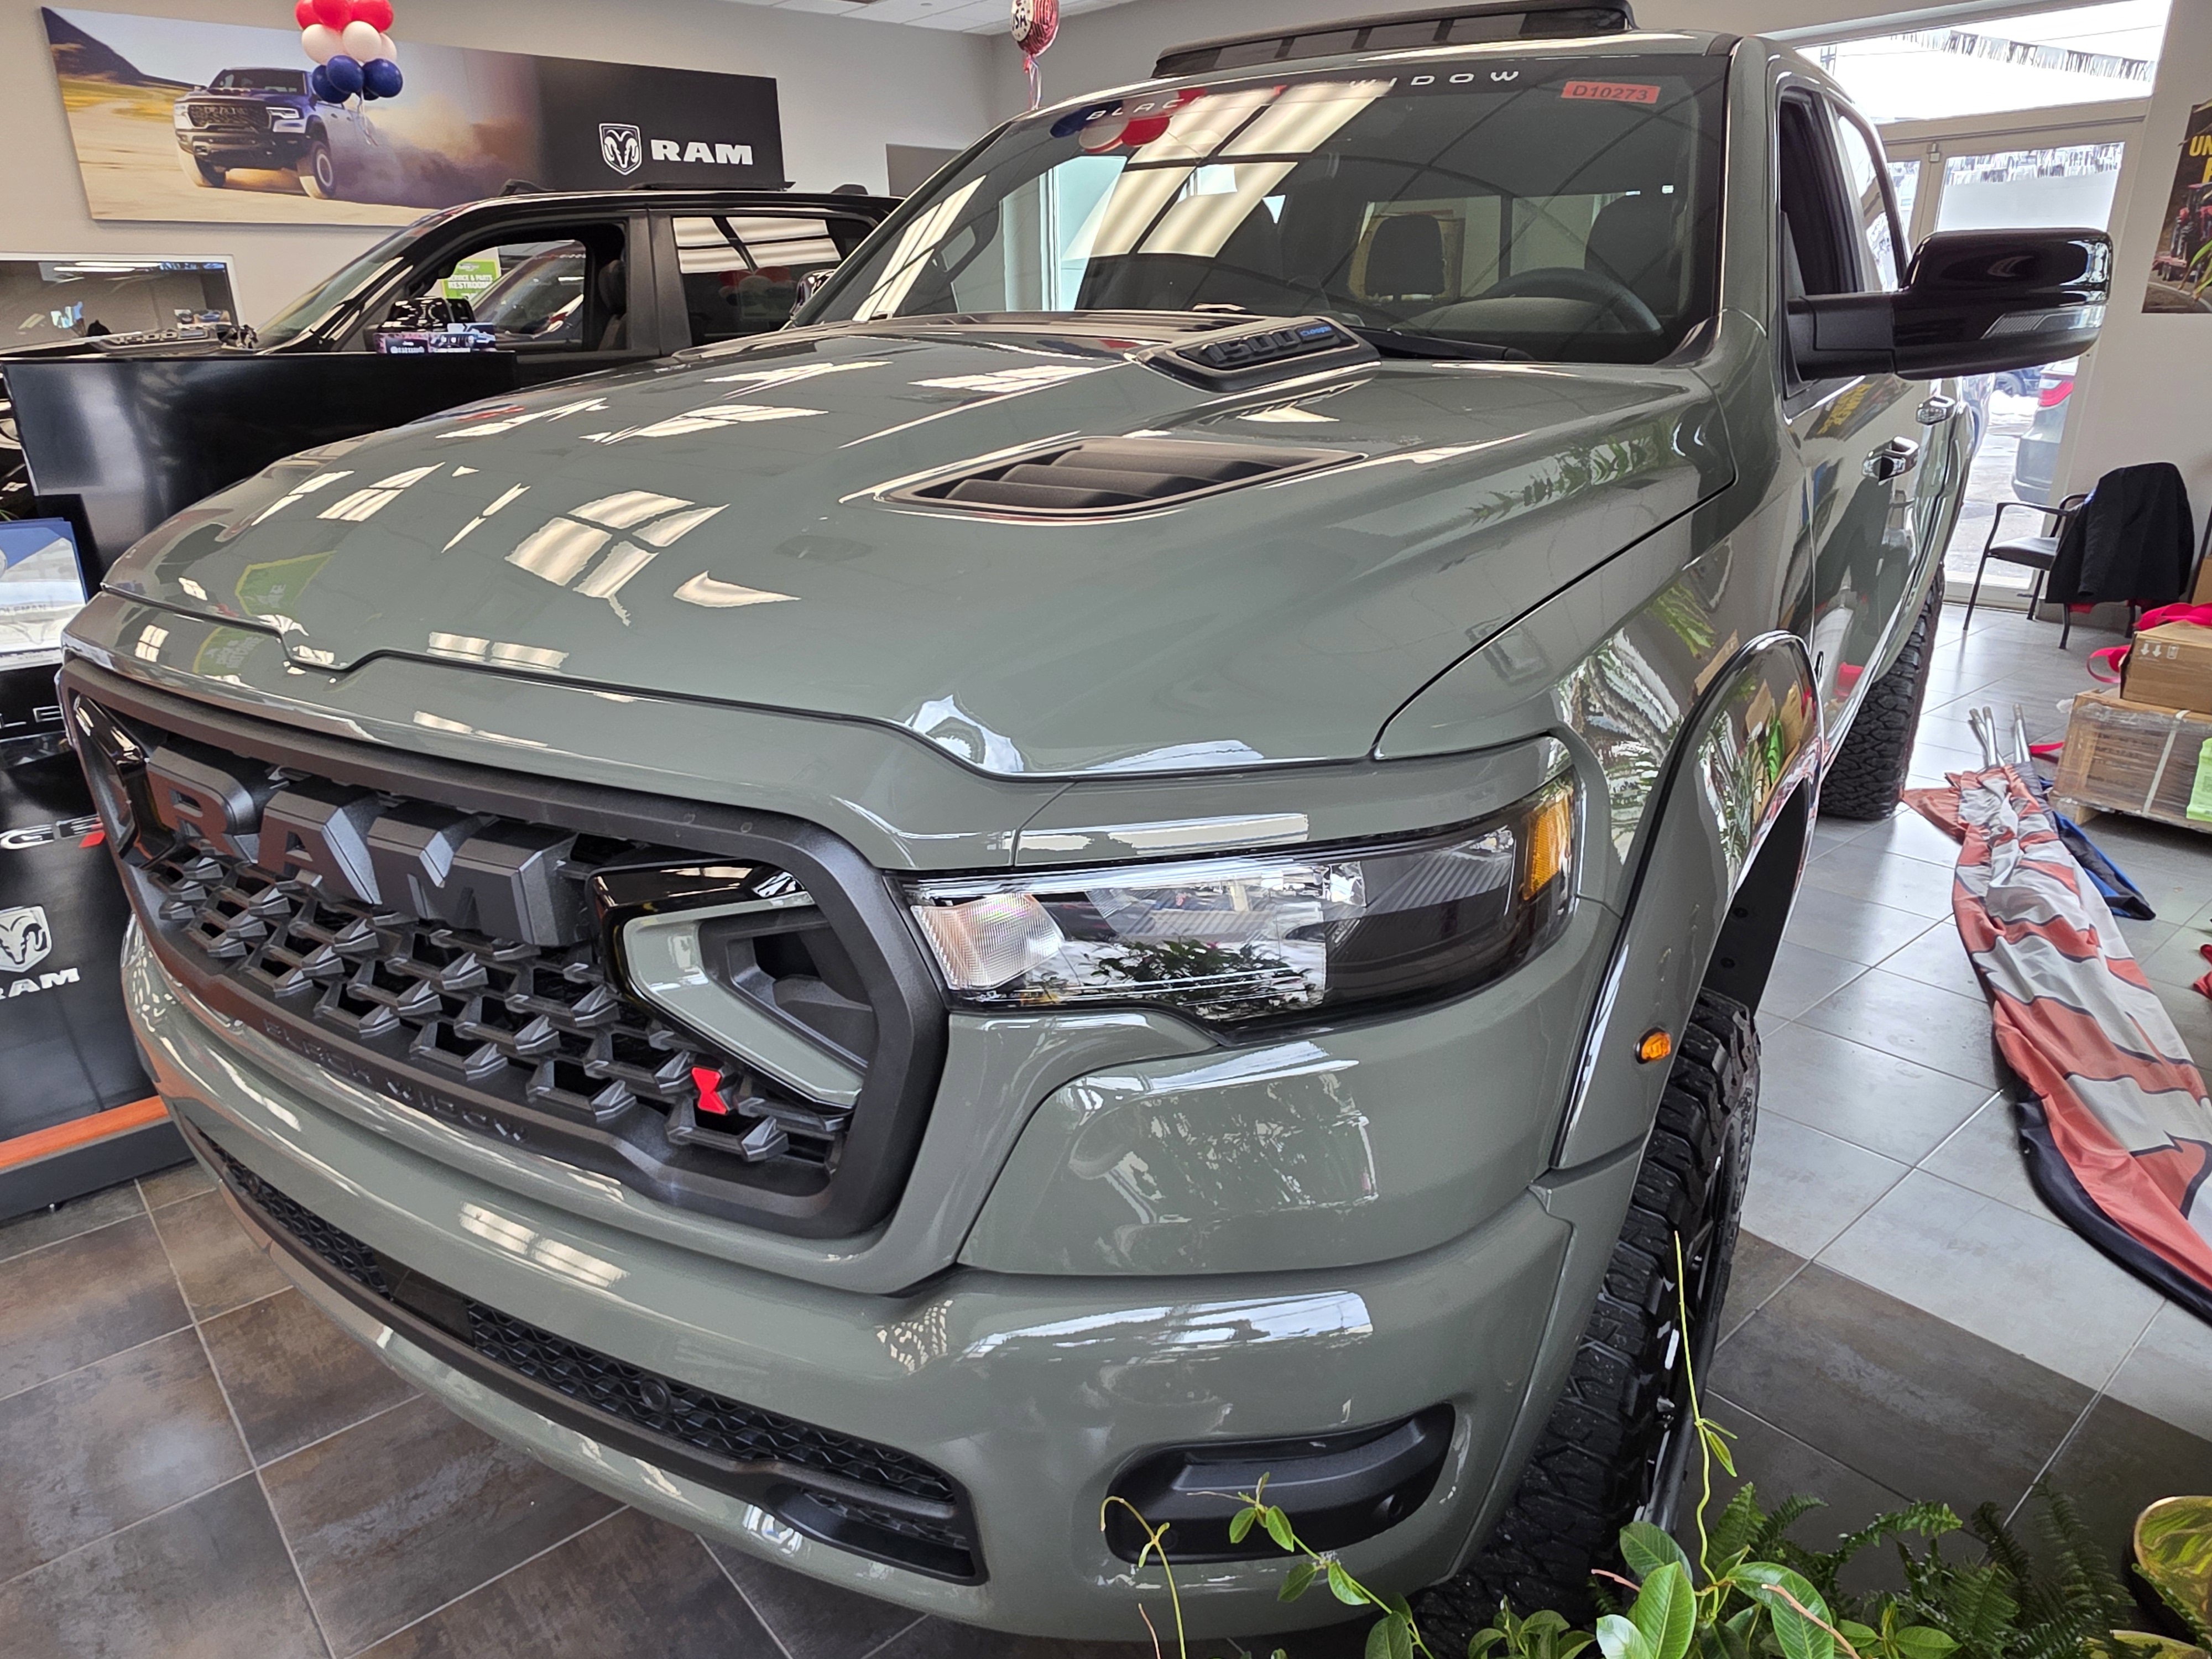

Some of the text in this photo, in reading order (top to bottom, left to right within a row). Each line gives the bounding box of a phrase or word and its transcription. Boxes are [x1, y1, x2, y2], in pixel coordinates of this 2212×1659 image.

[1572, 85, 1648, 101] D10273
[650, 139, 753, 165] RAM
[1200, 328, 1301, 364] 1500
[147, 745, 560, 946] RAM
[0, 968, 80, 1000] AM
[263, 1019, 528, 1143] BLACK WIDOW
